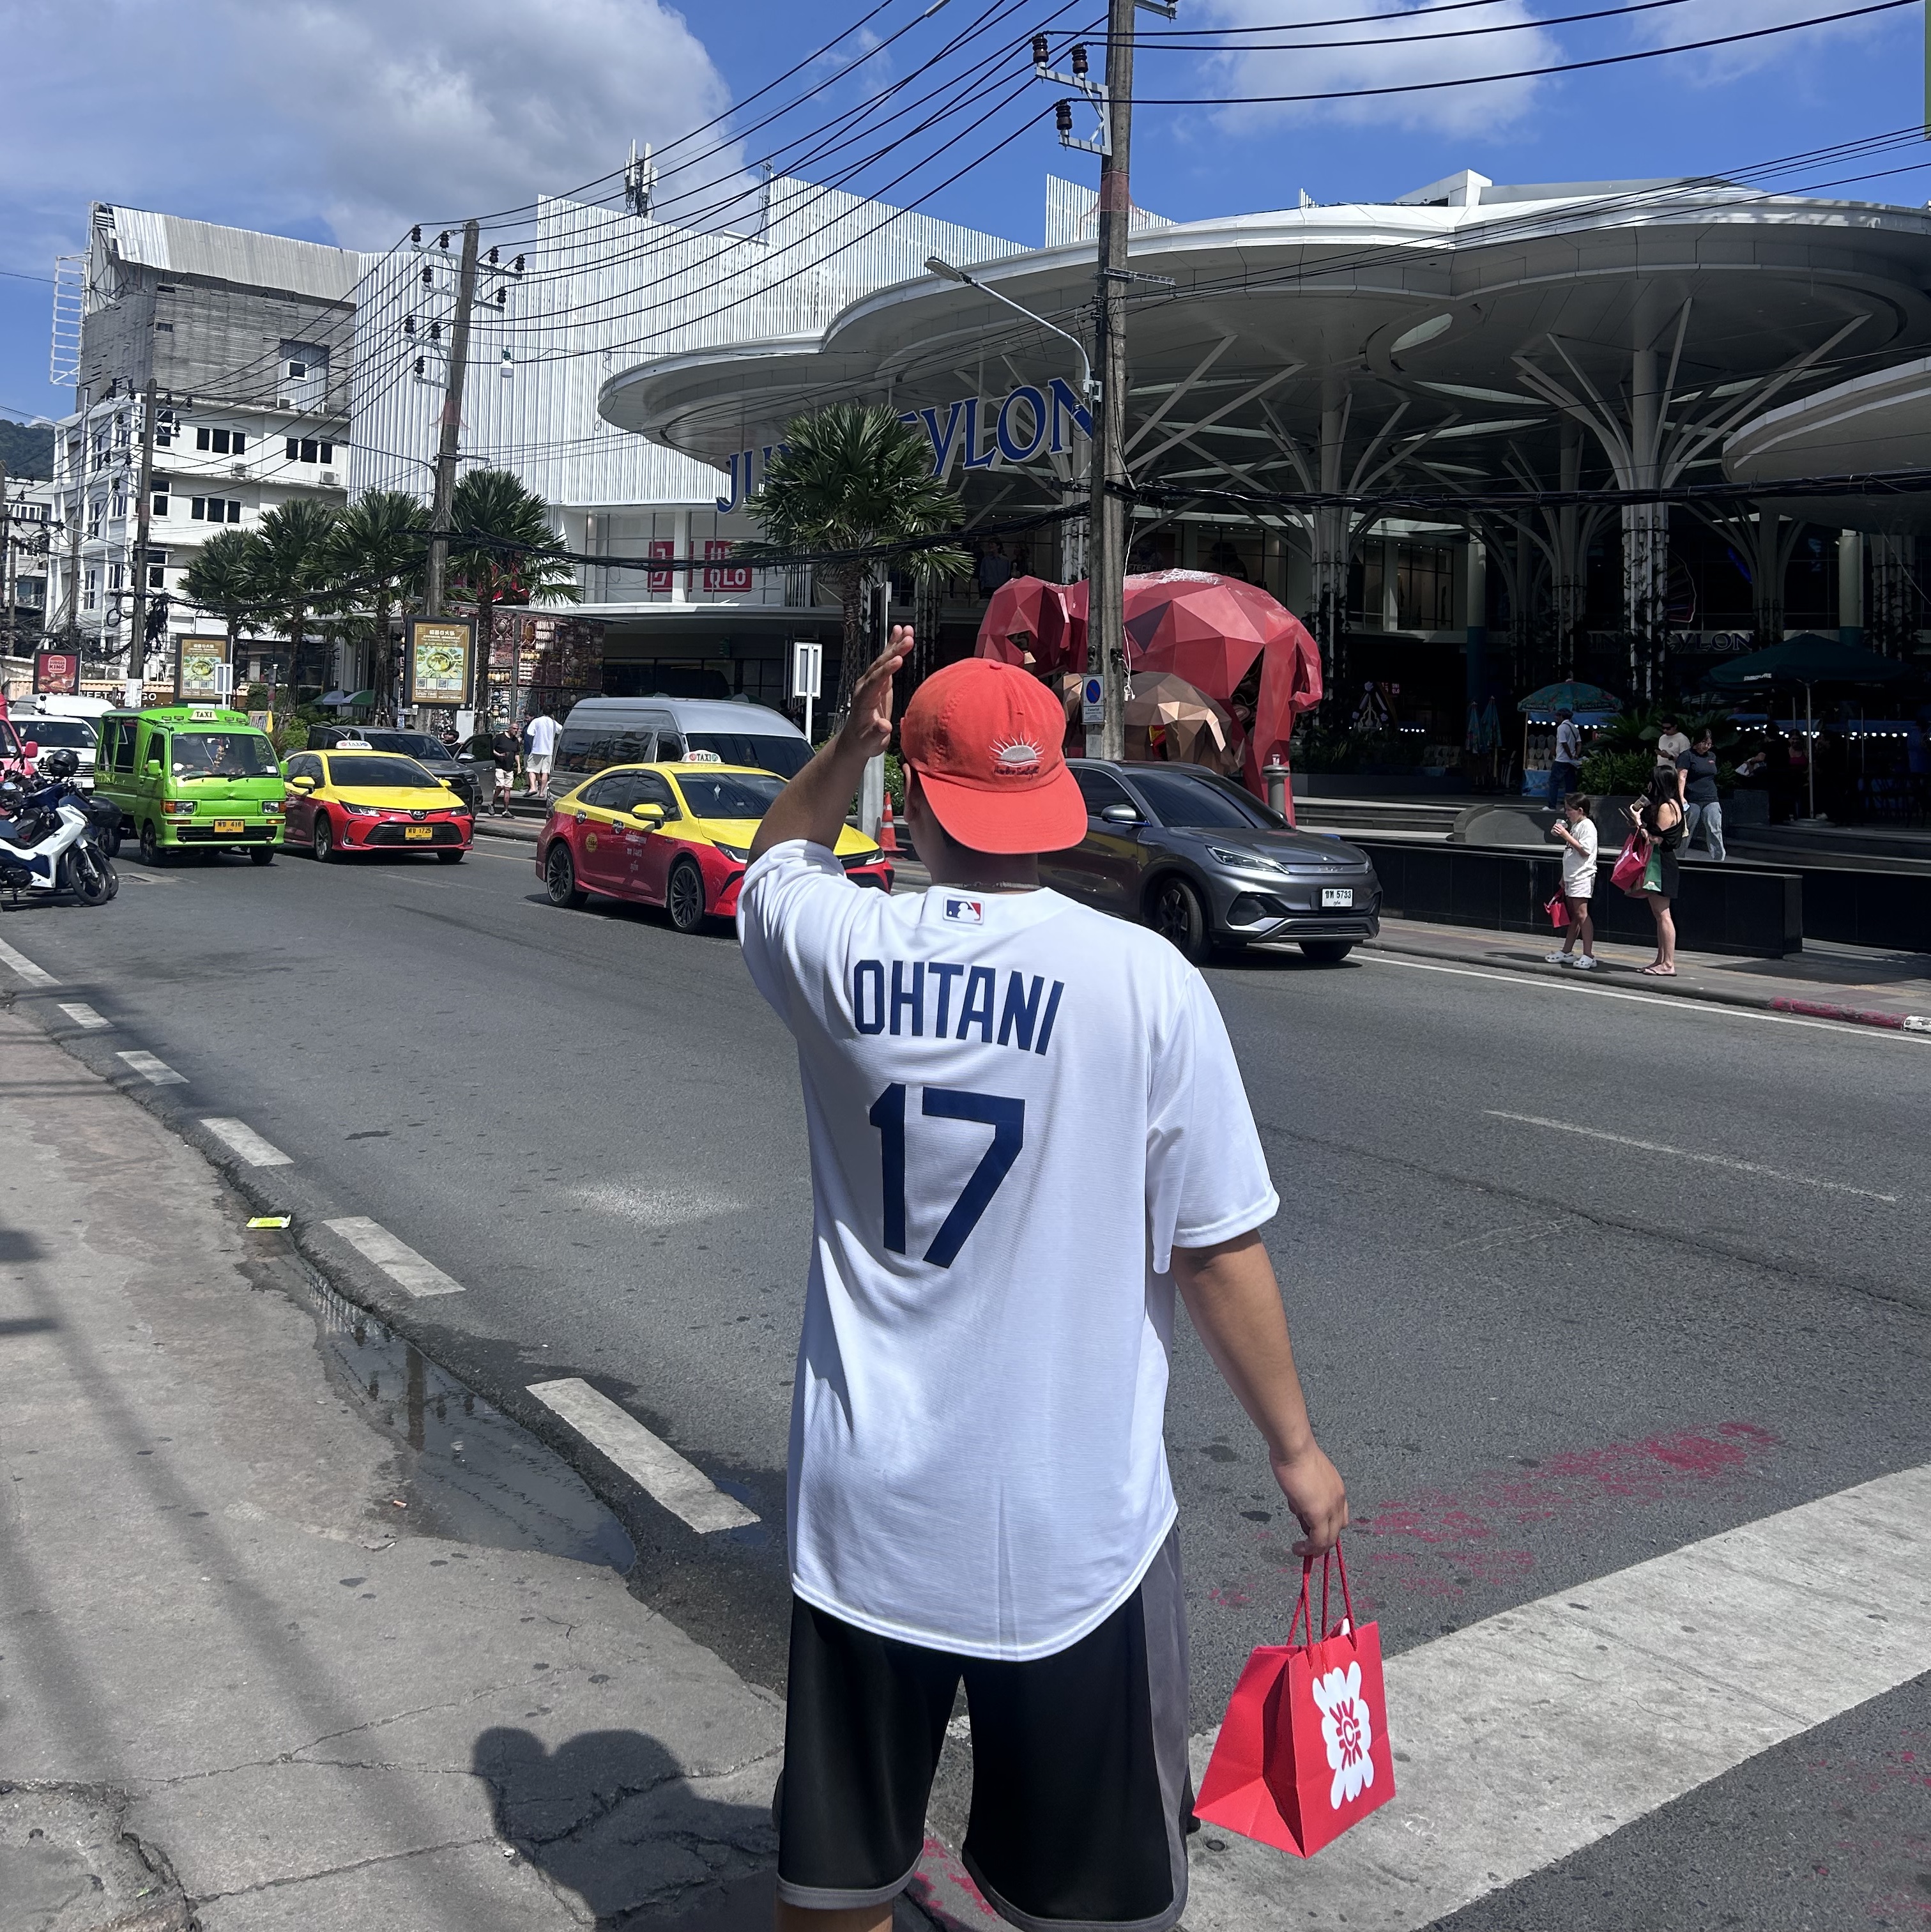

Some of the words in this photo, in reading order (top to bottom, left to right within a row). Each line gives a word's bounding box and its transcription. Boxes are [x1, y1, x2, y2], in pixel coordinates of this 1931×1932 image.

[710, 569, 746, 588] QLO
[696, 753, 712, 762] TAXI
[1336, 890, 1352, 899] 5733
[853, 959, 1065, 1056] OHTANI
[869, 1082, 1026, 1269] 17
